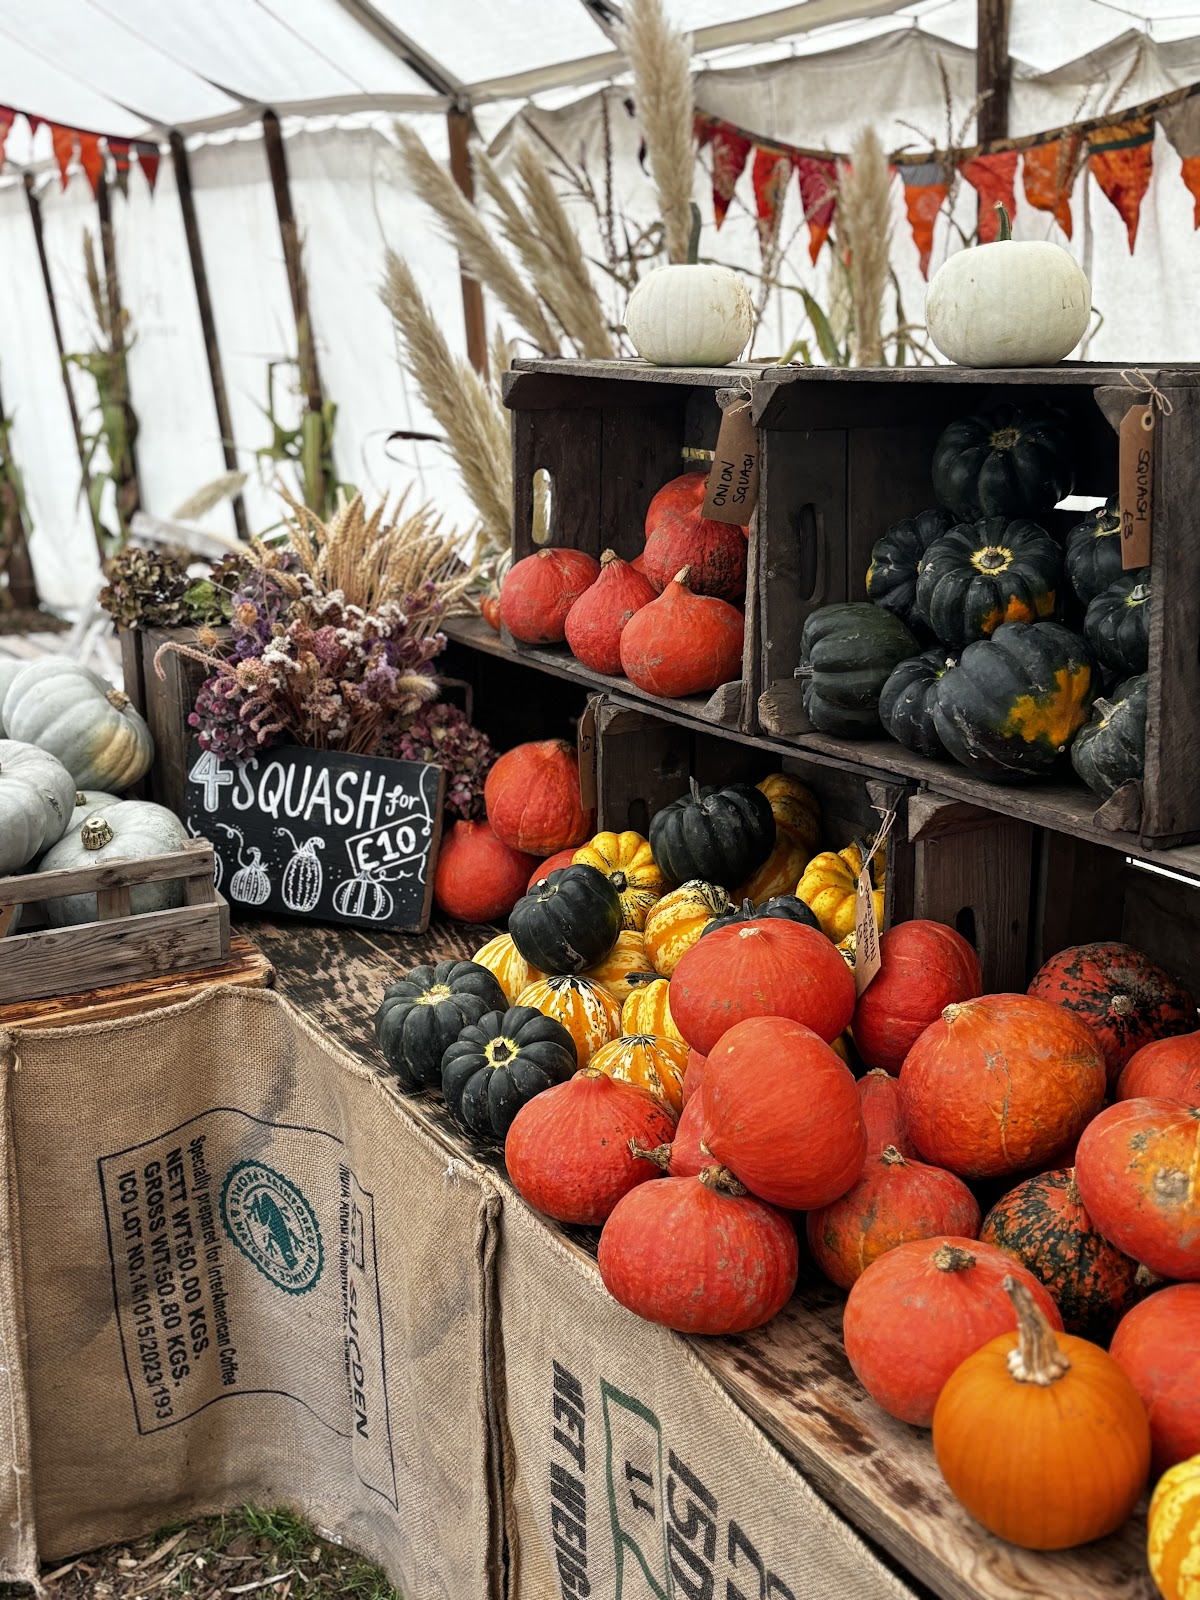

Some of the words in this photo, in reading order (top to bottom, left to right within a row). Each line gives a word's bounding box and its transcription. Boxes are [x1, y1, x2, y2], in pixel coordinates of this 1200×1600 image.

[712, 460, 735, 506] ONION
[732, 453, 755, 504] SQUASH
[1135, 447, 1150, 521] SQUASH
[188, 751, 234, 813] 4
[231, 757, 386, 830] SQUASH
[385, 785, 421, 817] for
[356, 825, 417, 871] £10
[117, 1169, 139, 1204] ICO
[186, 1134, 212, 1192] Specially
[122, 1205, 142, 1241] LOT
[193, 1191, 221, 1247] prepared
[143, 1161, 166, 1232] GROSS
[166, 1333, 191, 1388] KGS.
[166, 1147, 188, 1203] NETT
[187, 1305, 210, 1361] KGS.
[204, 1244, 223, 1264] for
[207, 1263, 232, 1347] InterAmerican
[219, 1347, 239, 1387] Coffee
[552, 1358, 586, 1474] NET
[550, 1461, 591, 1600] WEIG
